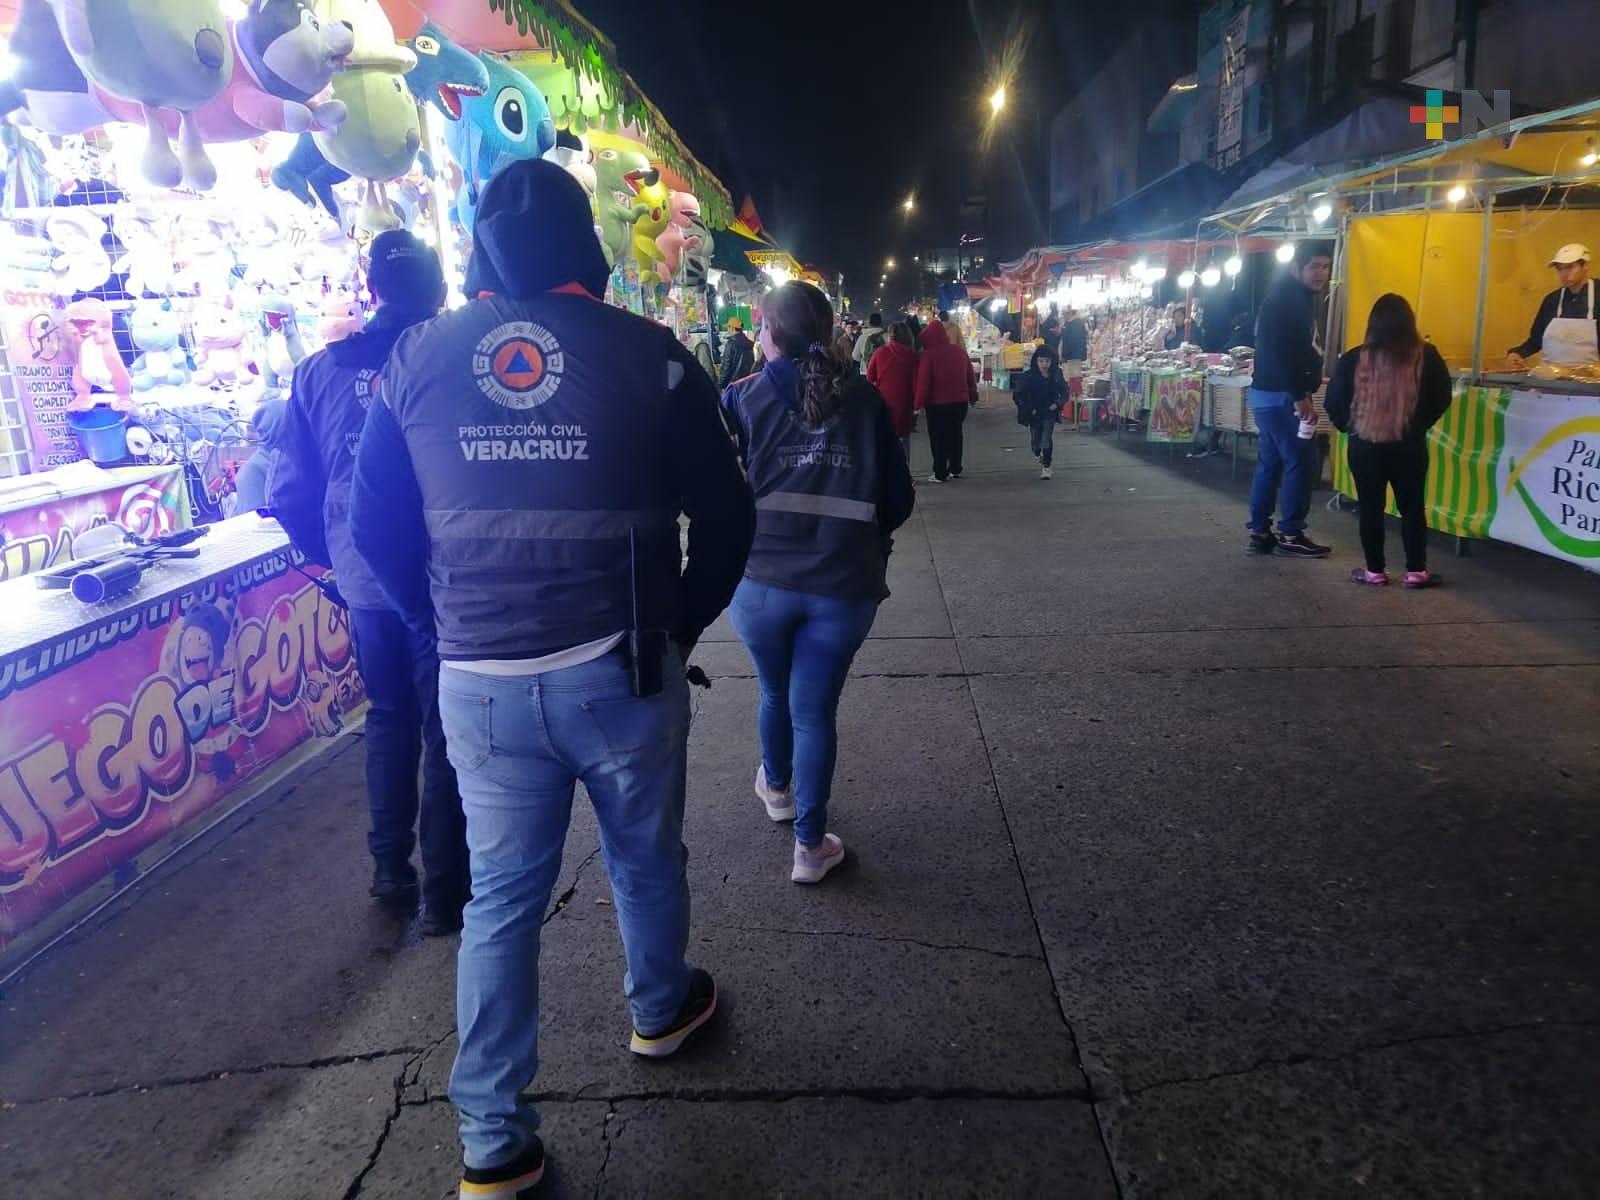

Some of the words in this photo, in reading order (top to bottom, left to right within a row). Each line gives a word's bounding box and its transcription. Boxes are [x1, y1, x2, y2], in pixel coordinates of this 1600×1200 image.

[459, 420, 547, 438] PROTECCIÓN
[551, 423, 588, 437] CIVIL
[460, 439, 590, 461] VERACRUZ
[178, 672, 236, 740] DE
